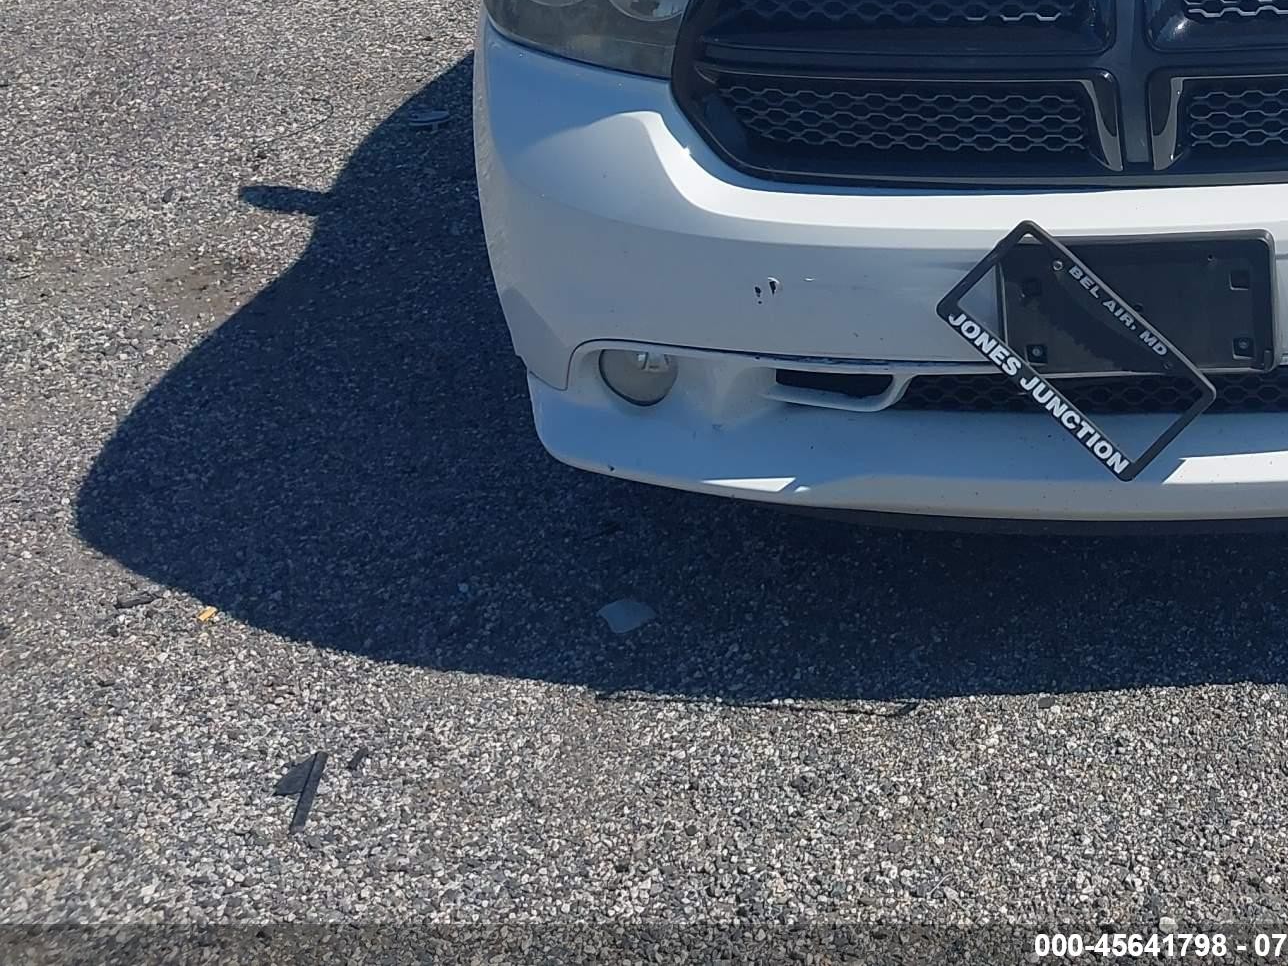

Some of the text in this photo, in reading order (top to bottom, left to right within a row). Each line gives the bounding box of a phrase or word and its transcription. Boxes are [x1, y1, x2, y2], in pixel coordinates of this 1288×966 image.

[1068, 265, 1169, 357] BEL AIR, MD
[948, 313, 1131, 475] JONES JUNCTION
